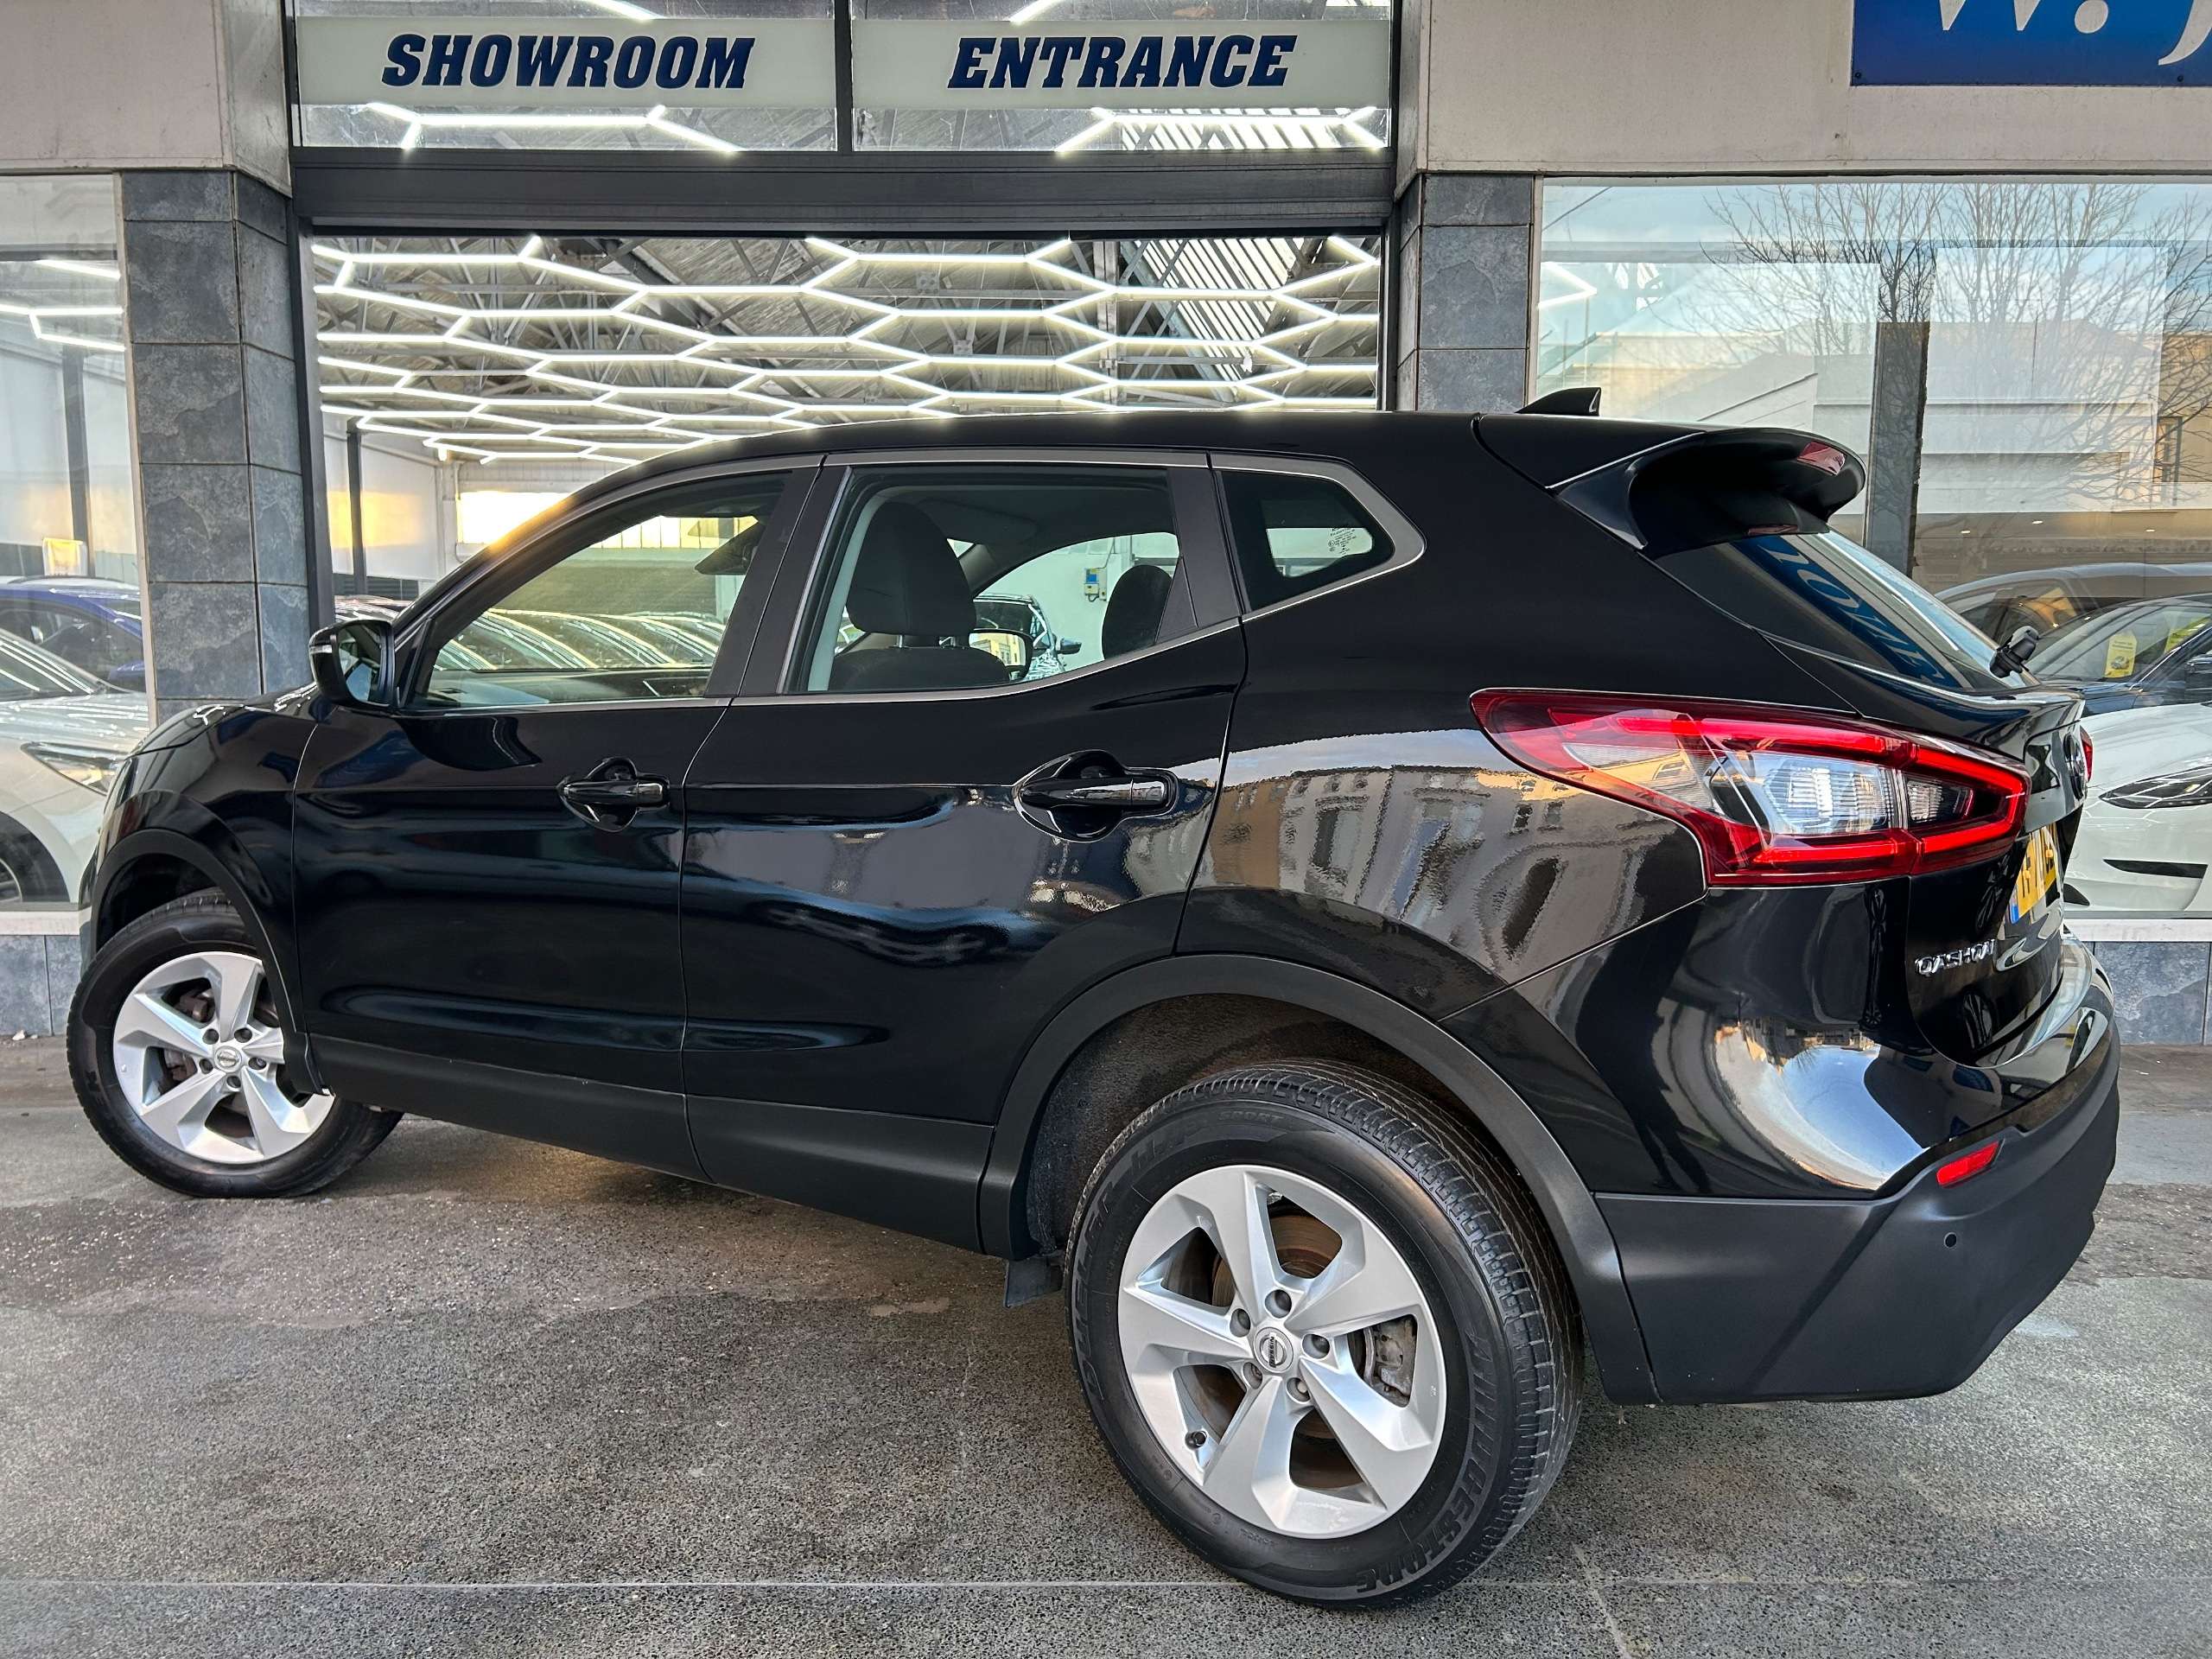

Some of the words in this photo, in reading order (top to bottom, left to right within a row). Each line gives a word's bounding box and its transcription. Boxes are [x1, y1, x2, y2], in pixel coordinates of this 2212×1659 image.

[381, 33, 756, 89] SHOWROOM
[947, 35, 1298, 89] ENTRANCE
[1217, 1109, 1285, 1122] SPORT
